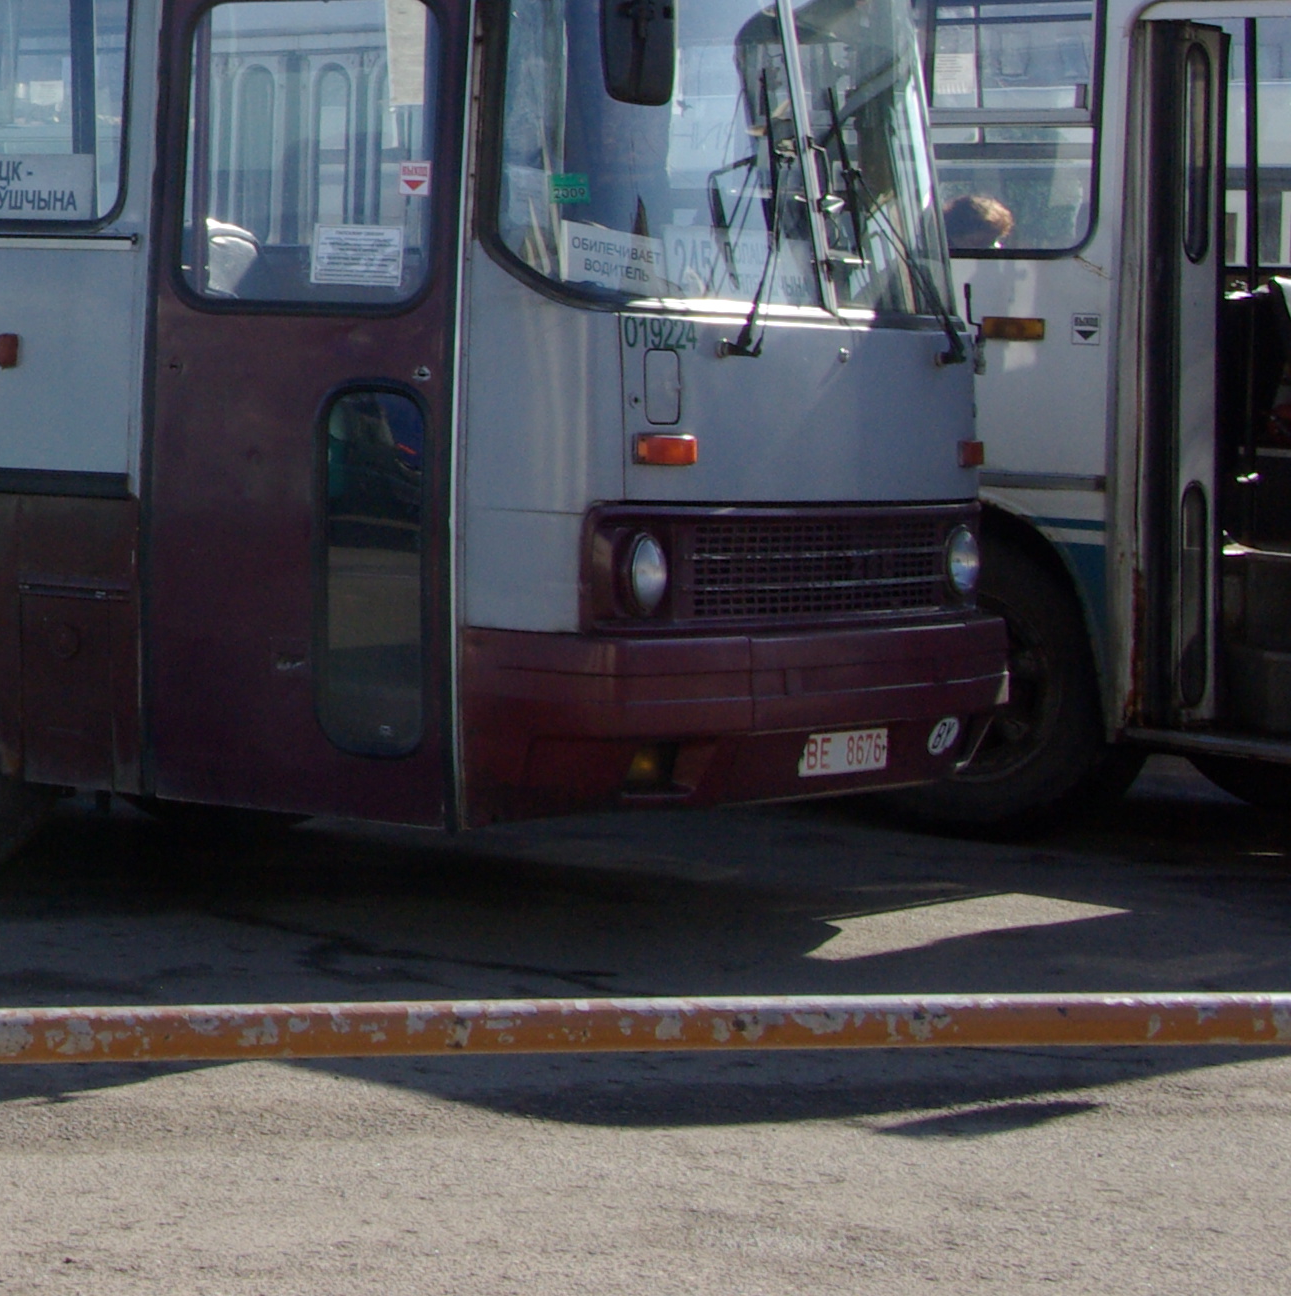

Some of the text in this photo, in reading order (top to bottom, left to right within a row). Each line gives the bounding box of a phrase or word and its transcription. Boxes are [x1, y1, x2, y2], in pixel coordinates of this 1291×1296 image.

[553, 187, 585, 199] 2009
[572, 236, 661, 265] ОБИЛЕЧИВАЕТ
[584, 257, 650, 282] ВОДИТЕЛЬ
[624, 316, 698, 350] 019224
[932, 721, 956, 750] BY
[806, 732, 881, 770] BE 8676
